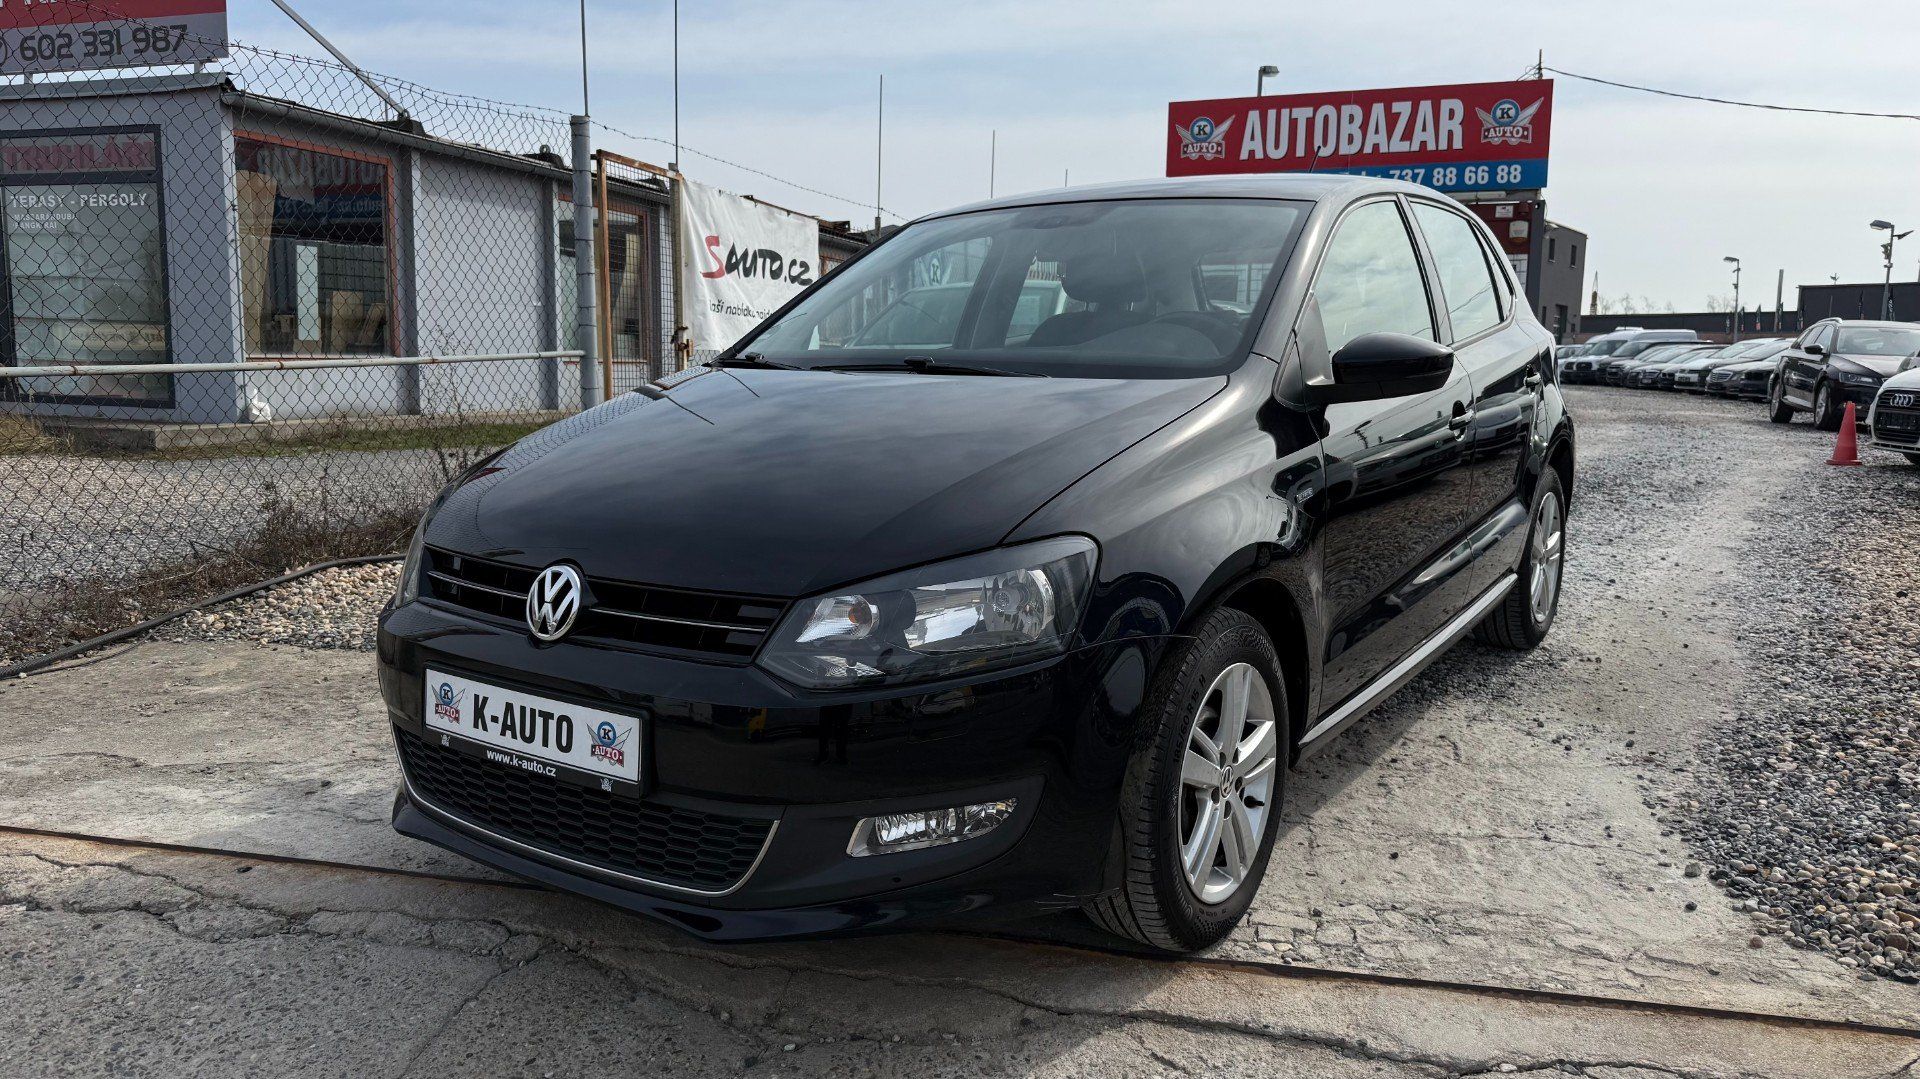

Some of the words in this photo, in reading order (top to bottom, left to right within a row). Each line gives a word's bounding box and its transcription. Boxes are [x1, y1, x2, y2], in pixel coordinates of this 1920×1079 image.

[20, 33, 73, 61] 602
[82, 30, 122, 57] 331
[132, 24, 187, 54] 987
[1498, 107, 1513, 119] K
[1196, 125, 1208, 136] K
[1239, 98, 1465, 161] AUTOBAZAR
[1488, 127, 1523, 138] AUTO
[1187, 143, 1217, 153] AUTO
[1389, 168, 1425, 186] 737
[1432, 167, 1457, 186] 88
[1464, 166, 1489, 185] 66
[1496, 165, 1522, 184] 88
[10, 195, 66, 208] TERASY
[79, 193, 147, 207] PERGOLY
[437, 705, 457, 719] AUTO
[472, 693, 574, 754] K-AUTO
[601, 727, 612, 741] K
[594, 745, 620, 762] AUTO
[486, 749, 557, 778] www.k-auto.cz
